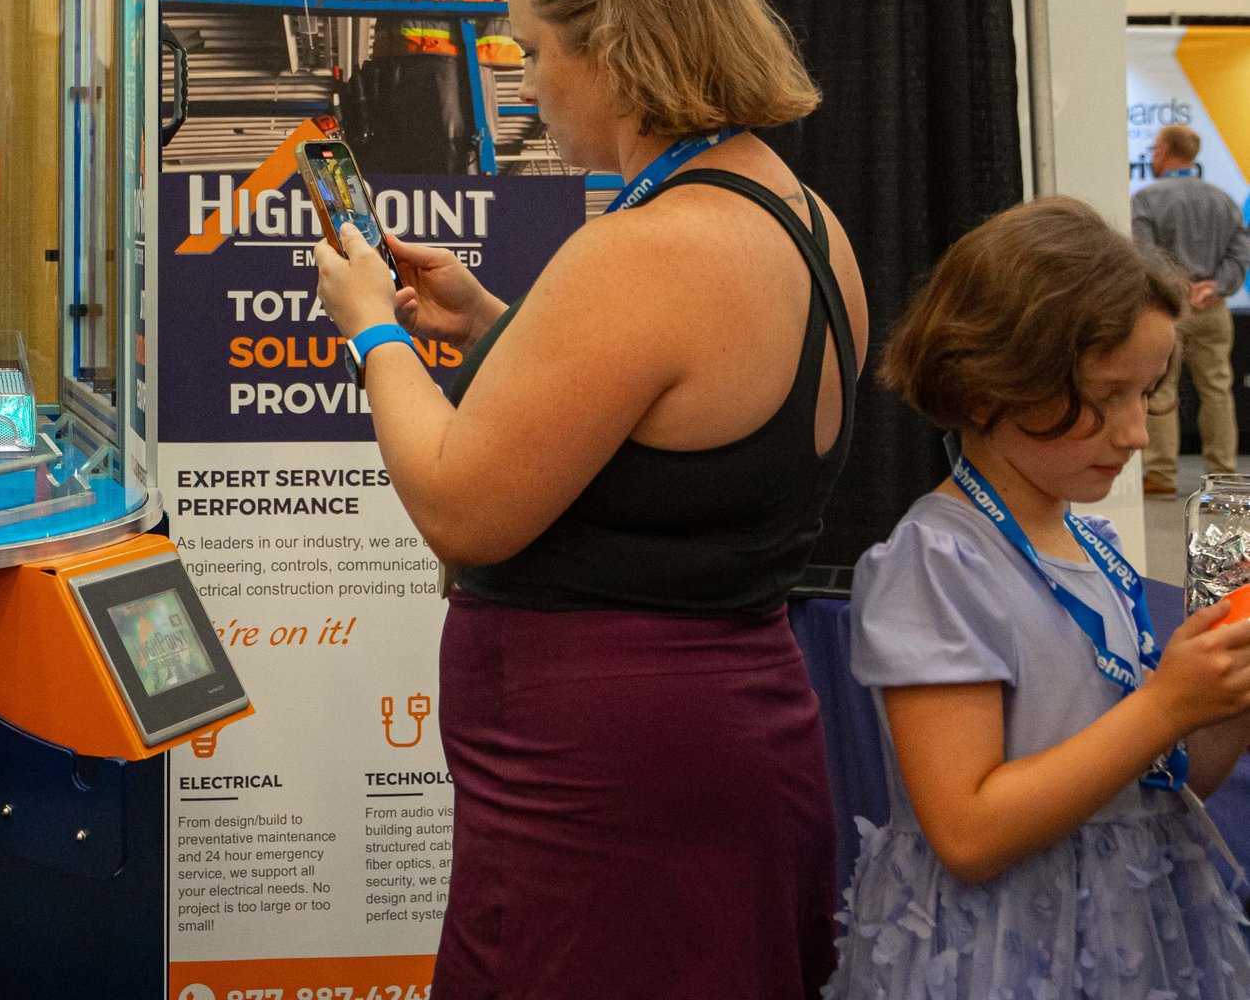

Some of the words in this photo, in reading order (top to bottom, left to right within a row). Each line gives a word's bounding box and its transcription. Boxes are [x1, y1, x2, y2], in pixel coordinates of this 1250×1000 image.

[227, 290, 336, 322] TOTA
[228, 336, 465, 368] SOLUNS
[177, 470, 270, 488] EXPERT
[275, 468, 391, 487] SERVICES
[952, 457, 1005, 522] ehmann
[177, 496, 359, 517] PERFORMANCE
[177, 536, 196, 550] As
[200, 536, 254, 550] leaders
[258, 536, 271, 549] in
[275, 538, 300, 550] our
[303, 535, 364, 552] industry,
[369, 537, 390, 548] we
[395, 537, 418, 548] are
[186, 559, 266, 577] ngineering,
[271, 558, 332, 574] controls,
[337, 556, 438, 573] communicatio
[196, 583, 241, 597] ctrical
[246, 582, 334, 597] construction
[338, 581, 405, 598] providing
[269, 626, 308, 646] on
[317, 616, 357, 646] it!
[179, 774, 283, 790] ELECTRICAL
[364, 771, 454, 787] TECHNOLO
[365, 807, 397, 819] From
[400, 805, 435, 818] audio
[438, 805, 454, 817] vis
[178, 815, 211, 828] From
[214, 813, 288, 830] design/build
[291, 814, 303, 826] to
[365, 822, 413, 838] building
[416, 822, 453, 835] autom
[177, 831, 254, 848] preventative
[257, 831, 337, 844] maintenance
[365, 839, 426, 853] structured
[429, 838, 452, 851] cab
[177, 850, 201, 863] and
[205, 850, 221, 862] 24
[224, 849, 253, 862] hour
[256, 849, 325, 864] emergency
[365, 857, 393, 870] fiber
[395, 856, 435, 872] optics,
[177, 867, 226, 881] service,
[230, 868, 248, 879] we
[251, 866, 298, 881] support
[301, 864, 315, 877] all
[365, 873, 416, 889] security,
[419, 876, 438, 887] we
[177, 886, 206, 900] your
[209, 883, 264, 897] electrical
[267, 882, 309, 896] needs.
[312, 882, 331, 894] No
[365, 891, 407, 907] design
[410, 891, 433, 903] and
[177, 901, 221, 917] project
[224, 900, 234, 913] is
[237, 901, 257, 913] too
[260, 900, 291, 916] large
[294, 901, 308, 912] or
[311, 899, 331, 911] too
[365, 907, 409, 924] perfect
[411, 908, 446, 922] syste
[177, 918, 215, 932] small!
